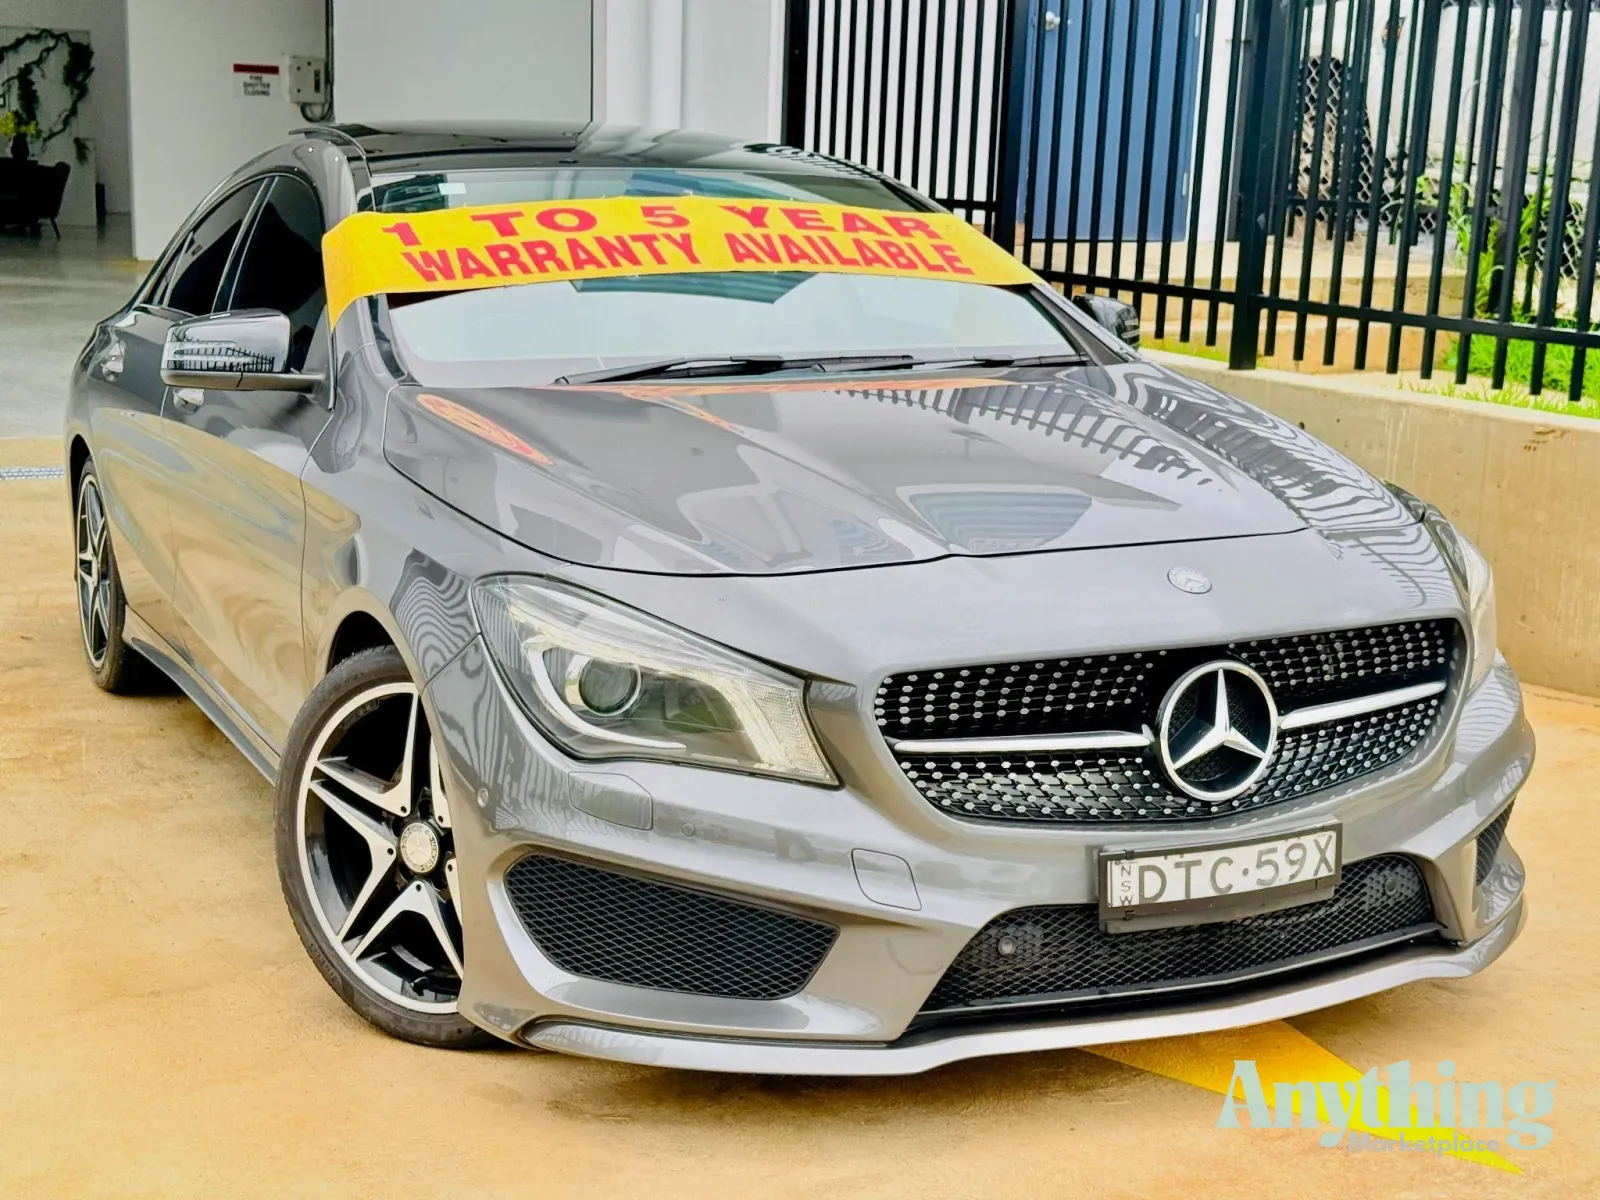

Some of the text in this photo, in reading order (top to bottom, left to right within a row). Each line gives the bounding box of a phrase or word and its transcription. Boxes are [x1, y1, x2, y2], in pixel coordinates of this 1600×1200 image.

[382, 205, 944, 247] 1 TO 5 YEAR
[402, 232, 976, 282] WARRANTY AVAILABLE
